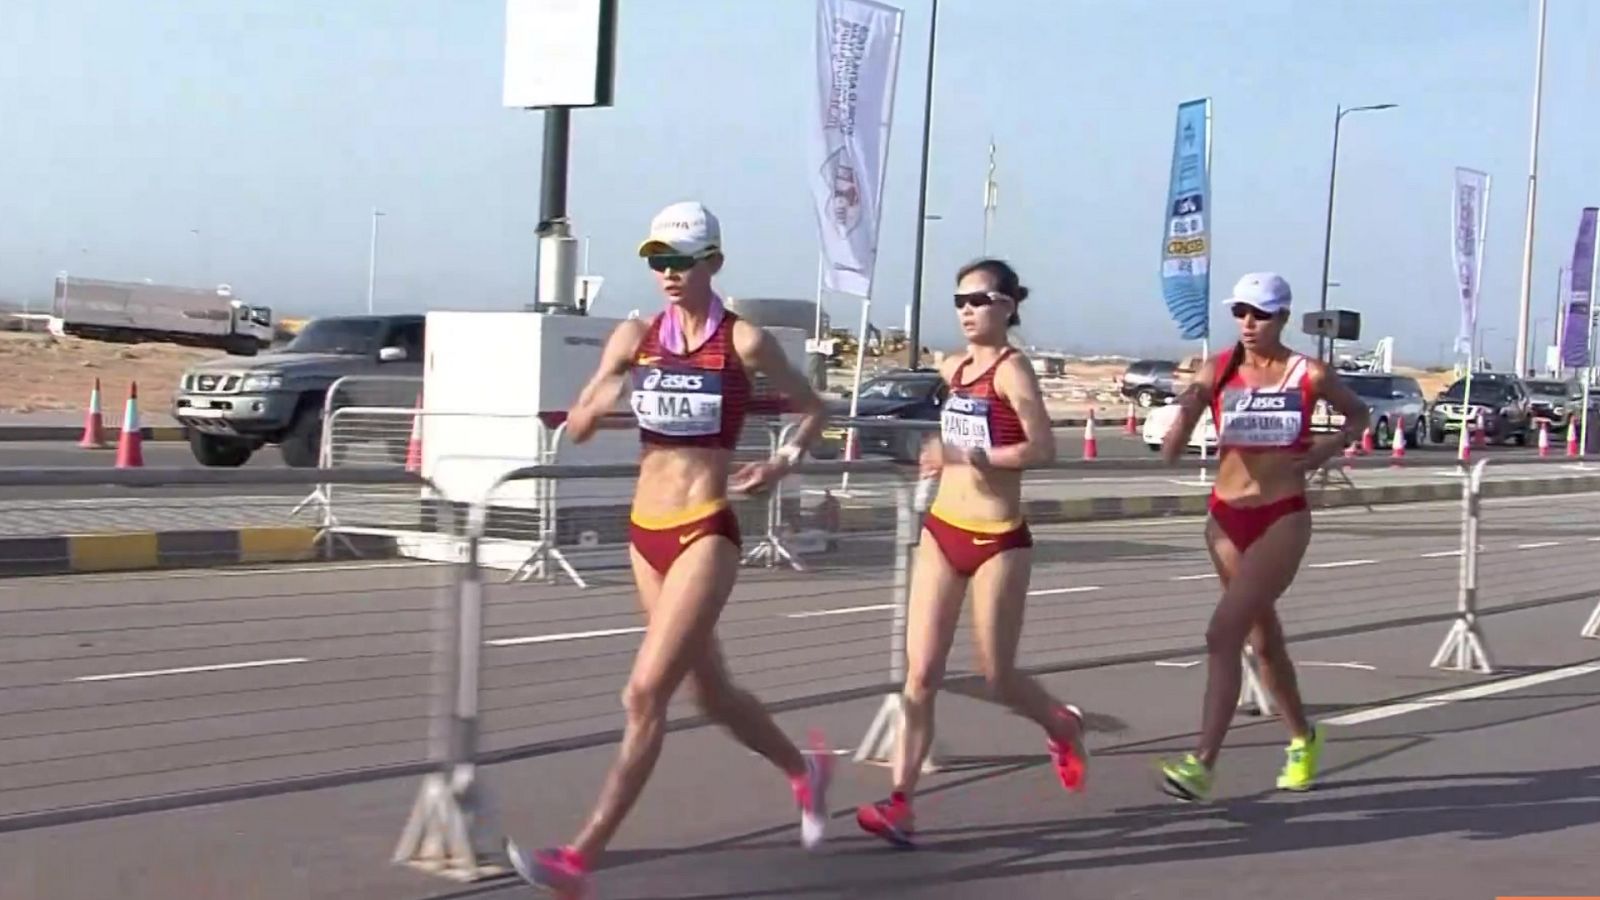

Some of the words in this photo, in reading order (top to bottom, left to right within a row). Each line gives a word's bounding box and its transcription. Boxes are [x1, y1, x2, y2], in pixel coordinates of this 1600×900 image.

[660, 375, 704, 390] asics
[658, 395, 693, 417] MA
[1251, 397, 1286, 409] asics
